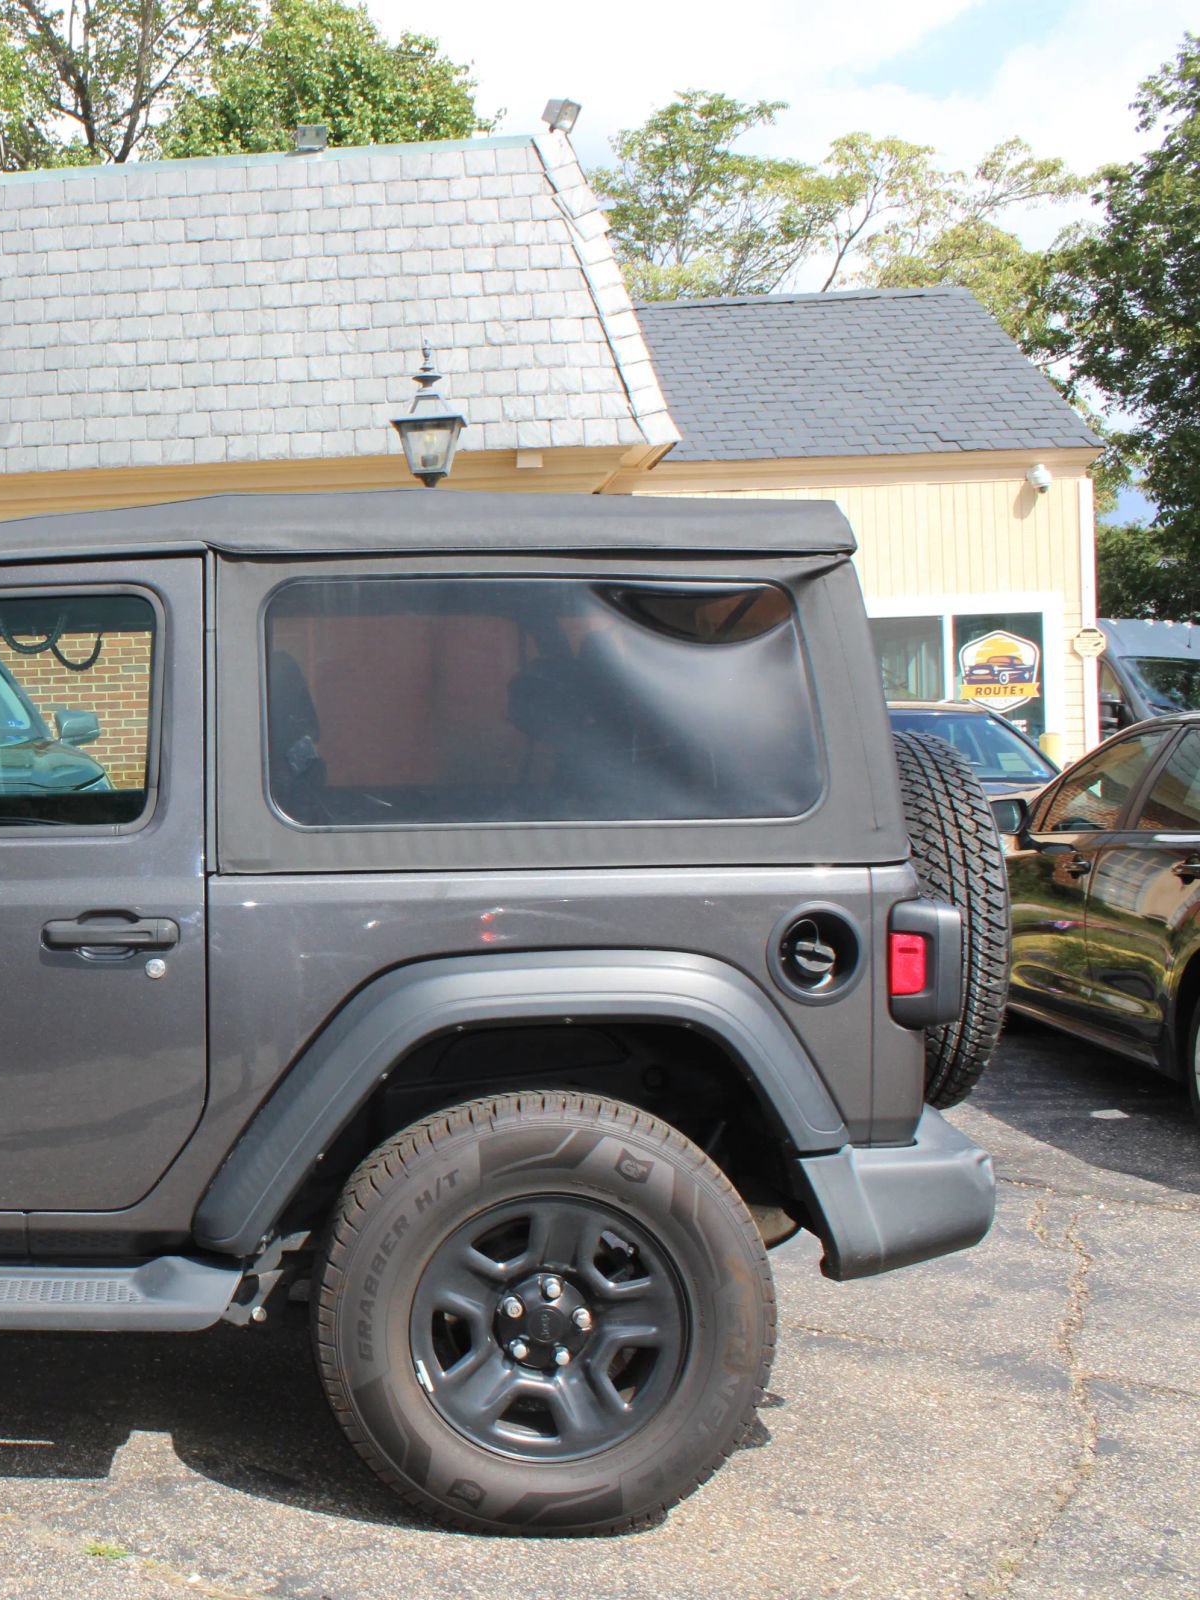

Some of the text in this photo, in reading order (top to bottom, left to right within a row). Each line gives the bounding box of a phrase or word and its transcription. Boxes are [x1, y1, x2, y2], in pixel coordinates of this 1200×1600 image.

[975, 686, 1017, 696] ROUTE
[356, 1167, 461, 1363] GRABBER H/T
